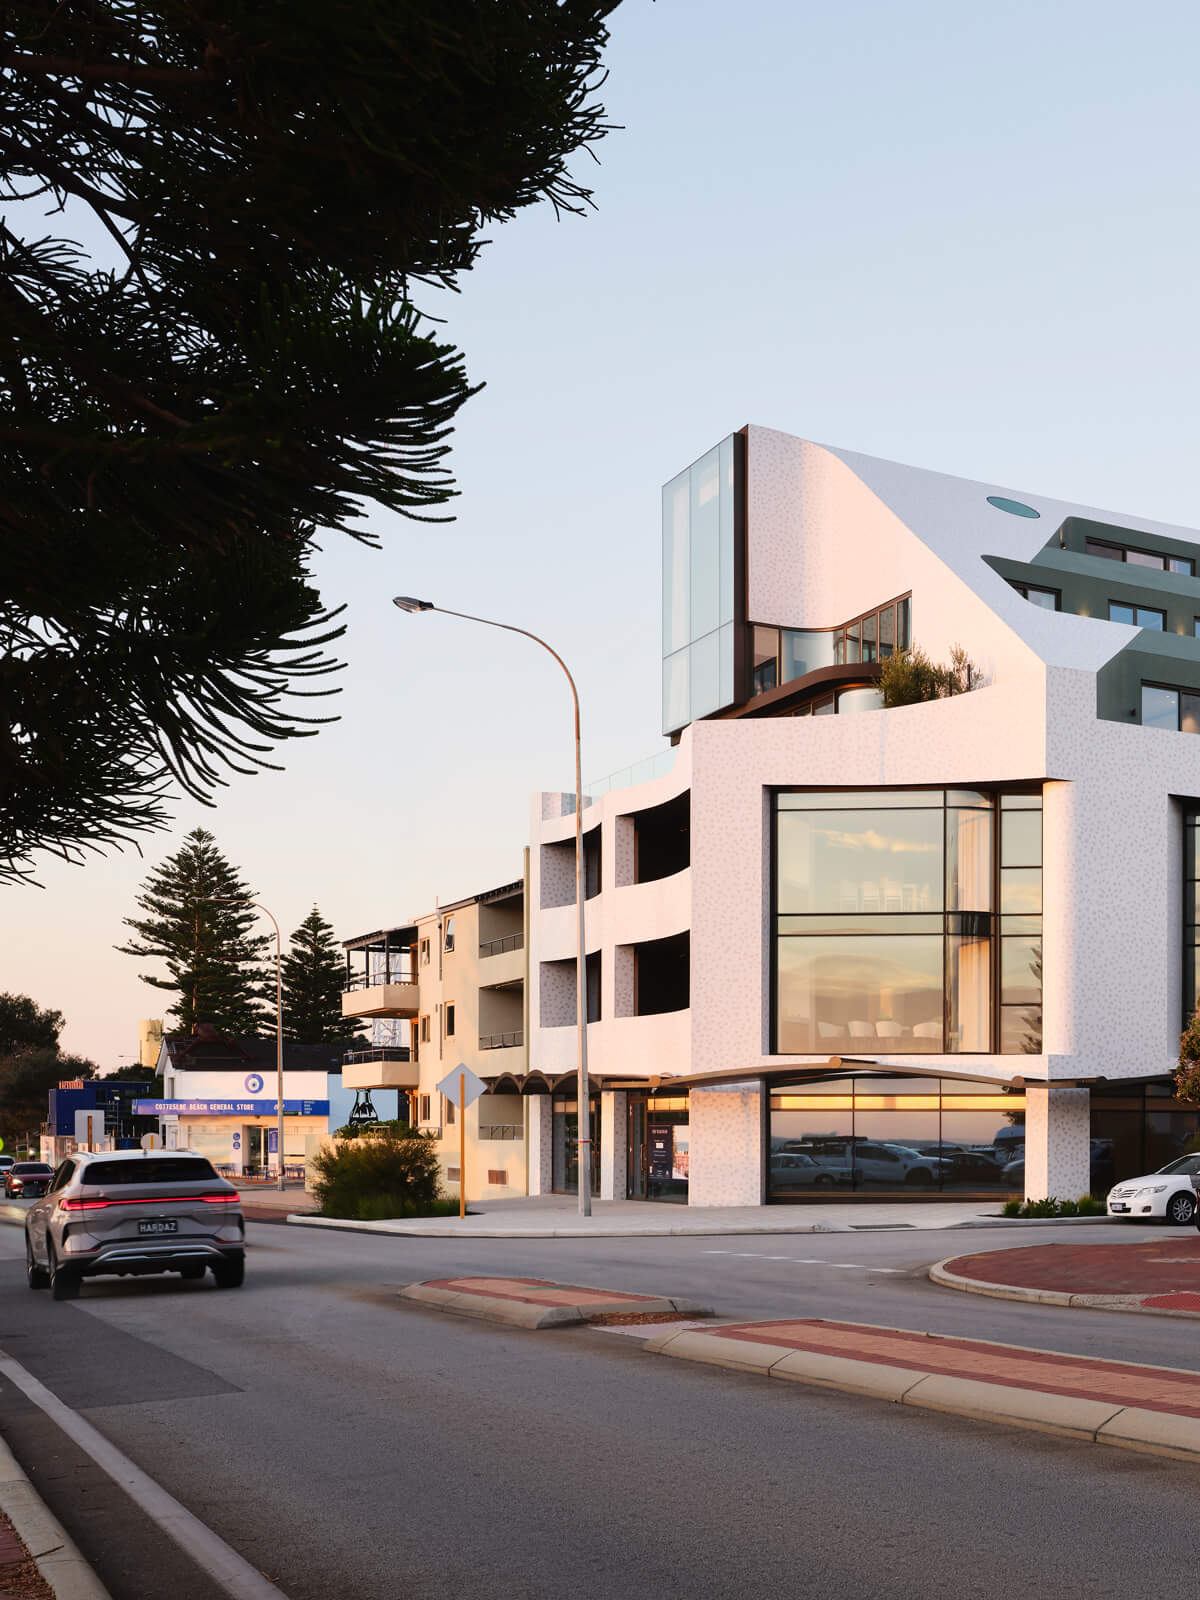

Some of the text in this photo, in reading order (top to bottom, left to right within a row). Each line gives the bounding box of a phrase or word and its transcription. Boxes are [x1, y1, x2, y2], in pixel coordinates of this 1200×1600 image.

[155, 1103, 255, 1111] COTTESLOE BEACH GENERAL STORE
